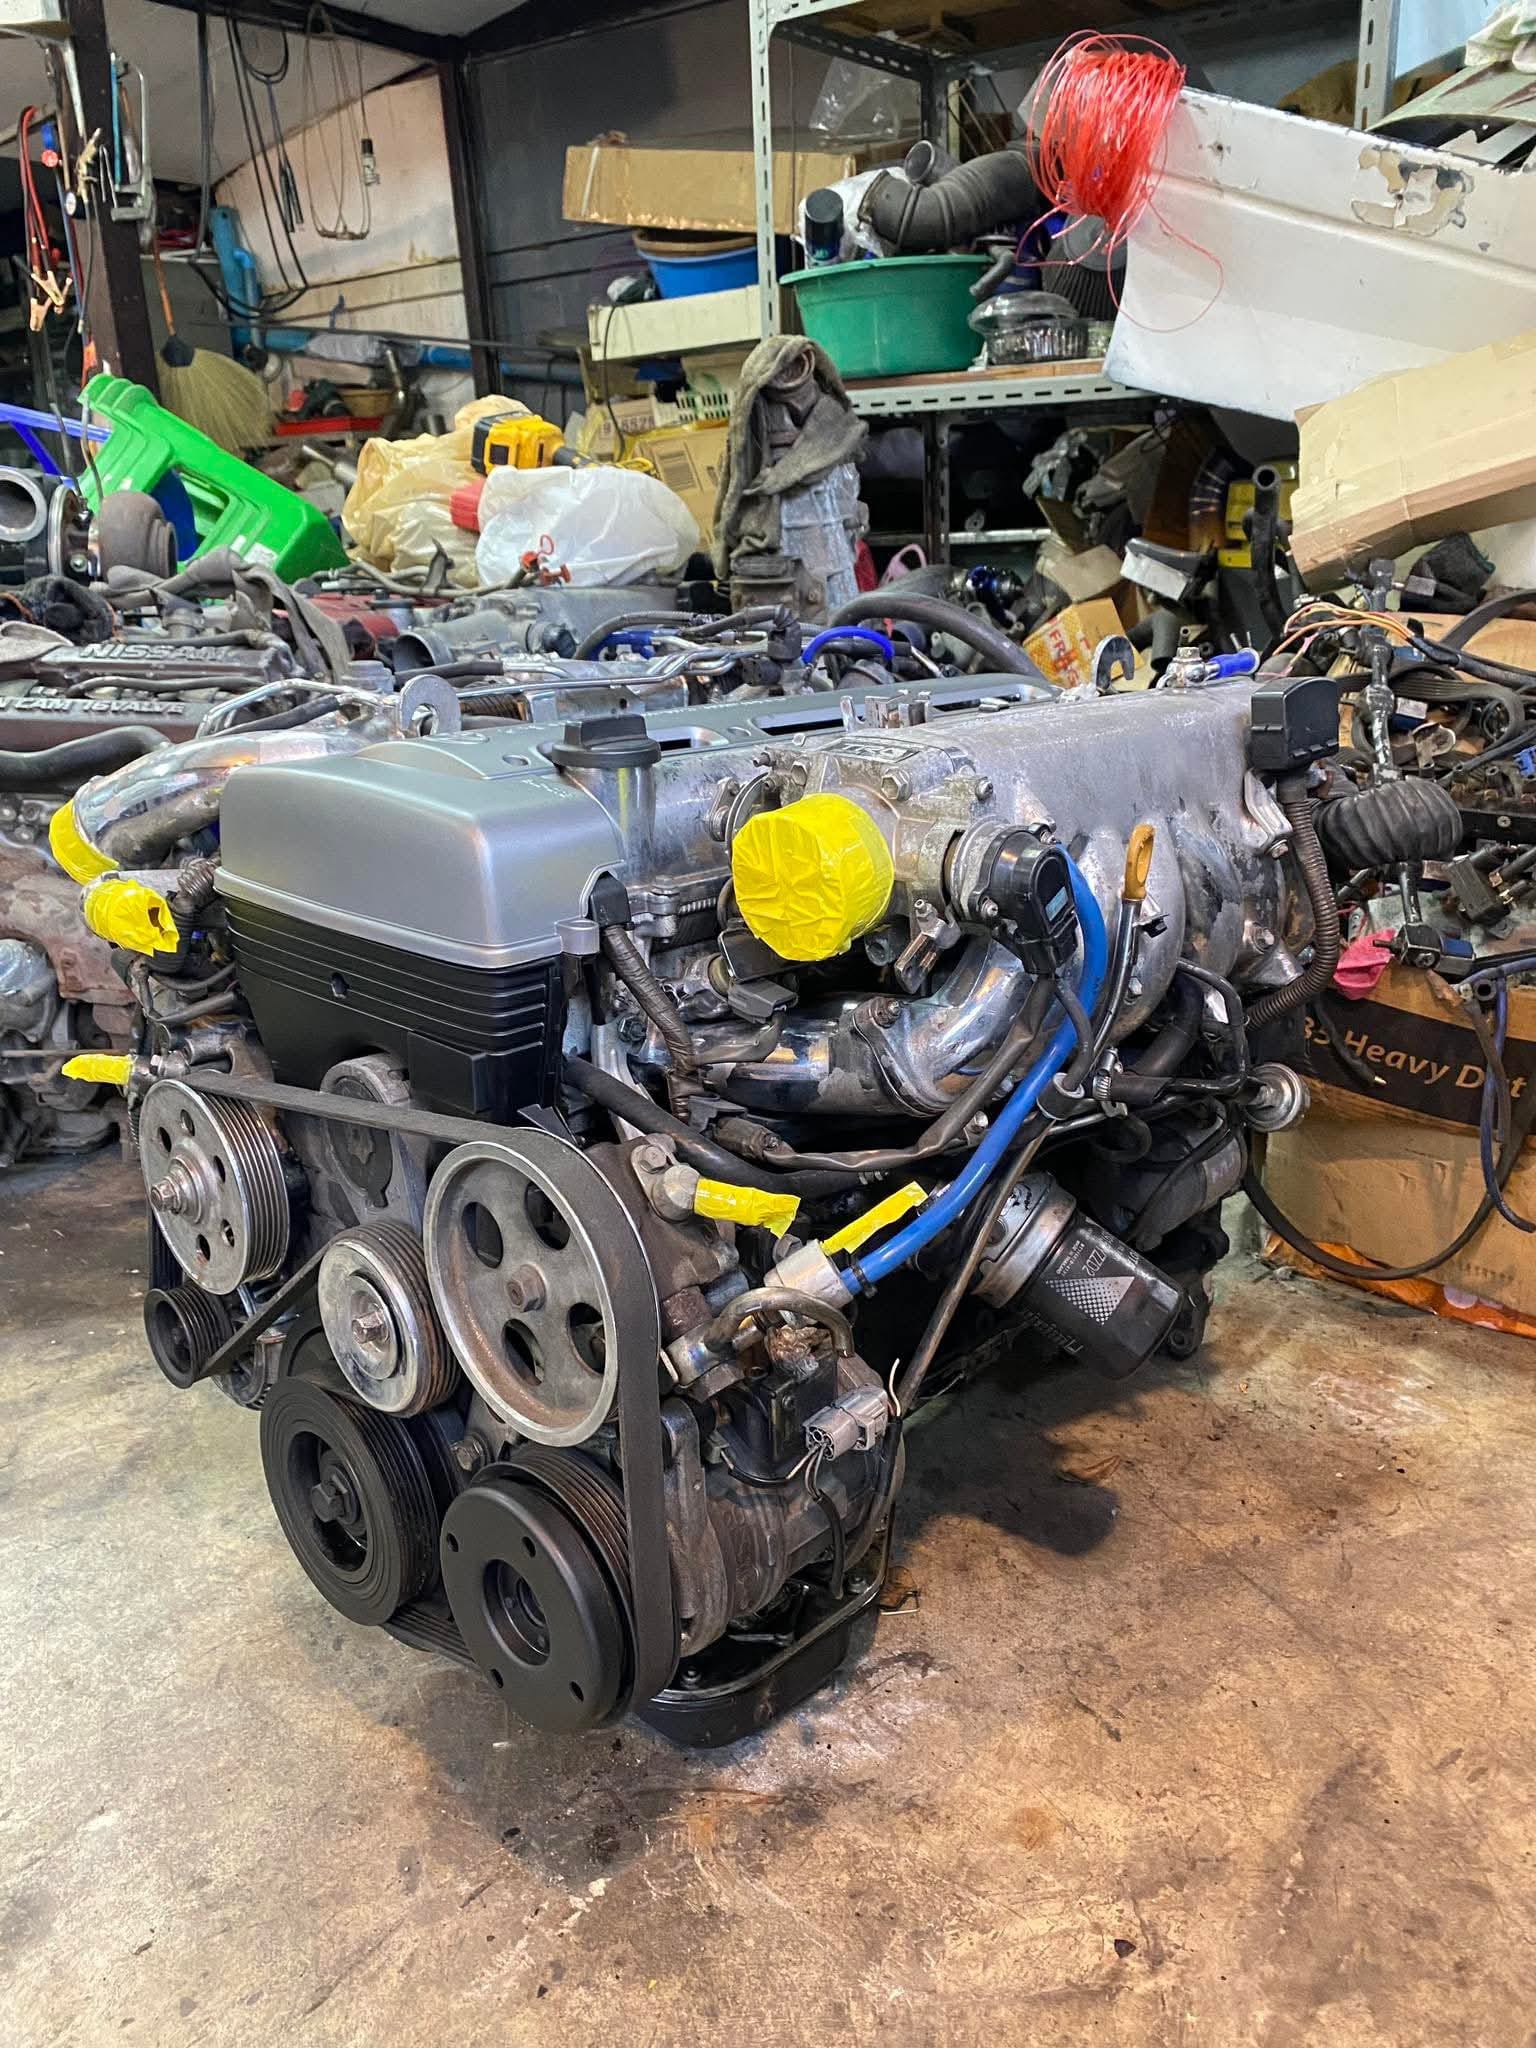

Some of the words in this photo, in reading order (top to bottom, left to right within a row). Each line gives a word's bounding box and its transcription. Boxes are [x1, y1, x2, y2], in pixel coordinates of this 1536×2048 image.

[79, 643, 226, 662] NISSAN
[15, 697, 72, 712] CAM
[1344, 1030, 1450, 1085] Heavy
[1455, 1064, 1527, 1098] Dt
